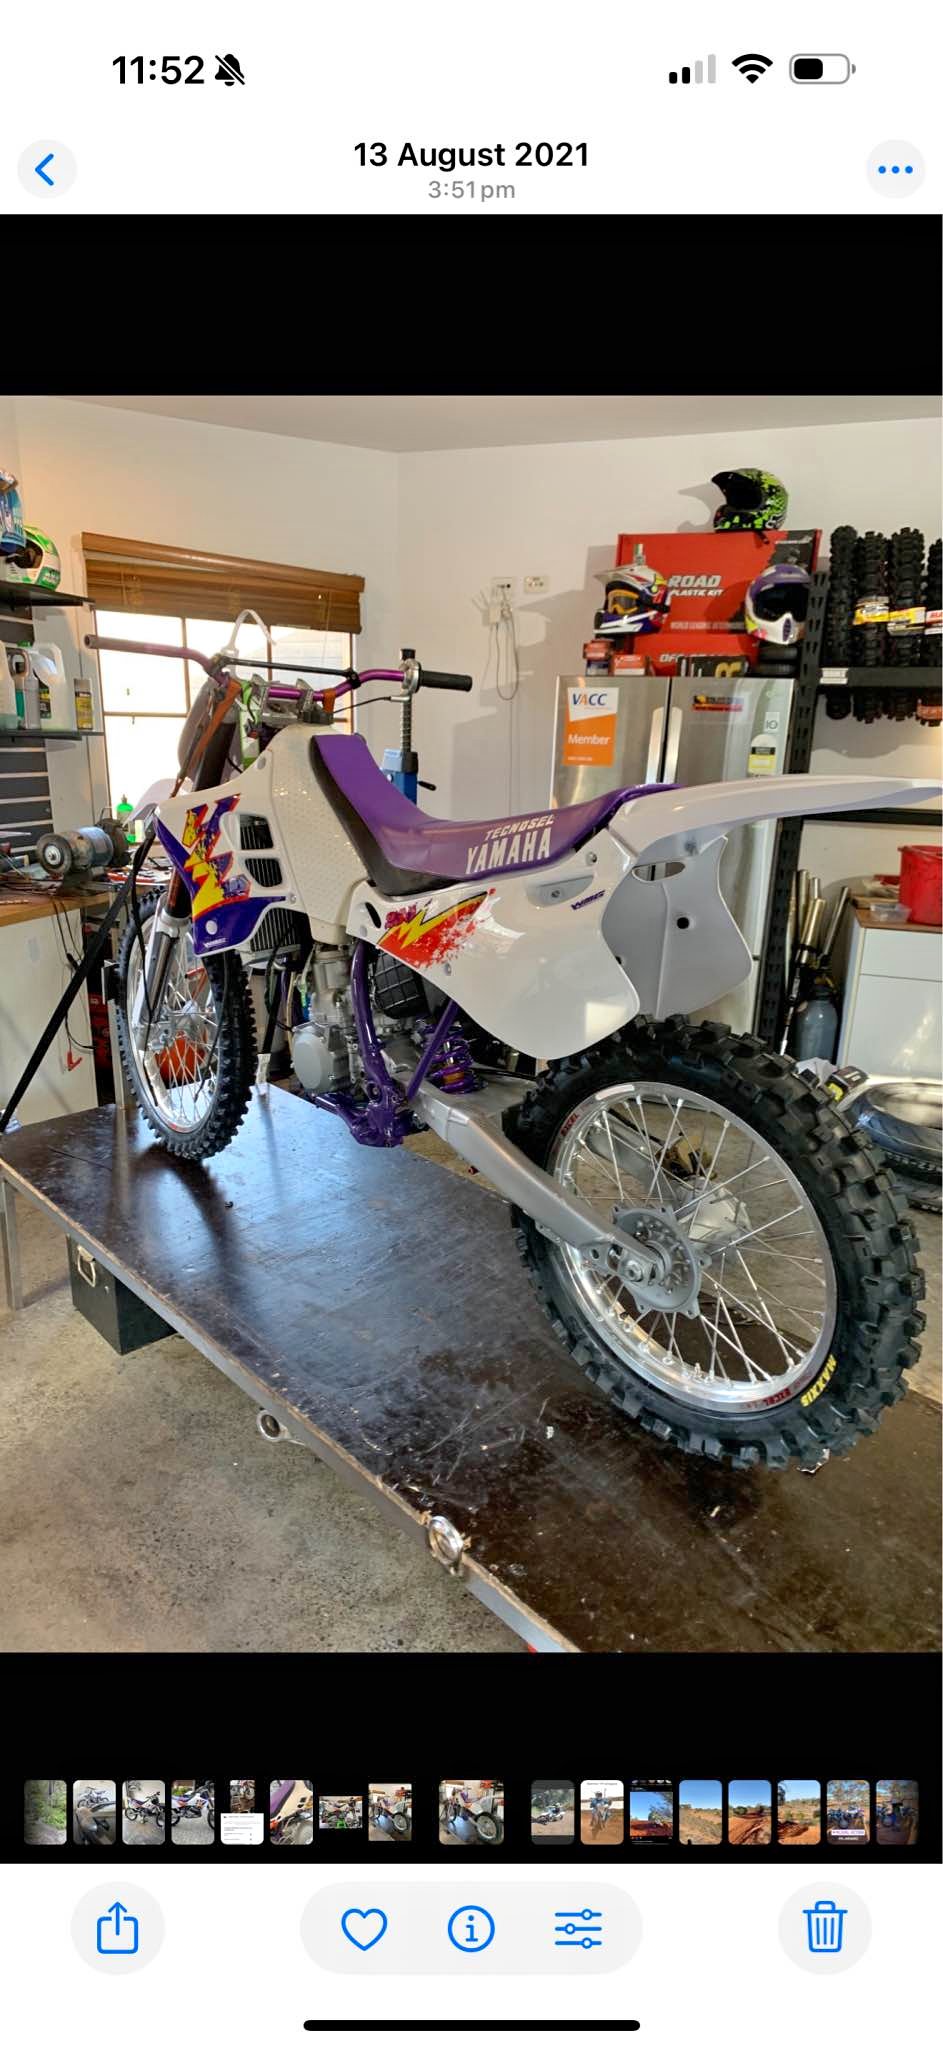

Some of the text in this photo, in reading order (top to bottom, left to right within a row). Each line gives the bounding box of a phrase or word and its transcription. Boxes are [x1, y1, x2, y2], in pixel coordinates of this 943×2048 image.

[668, 575, 721, 587] ROAD
[572, 693, 608, 706] VACC
[567, 734, 611, 745] Member
[465, 827, 552, 875] YAMAHA
[800, 1353, 838, 1408] MAXXIS
